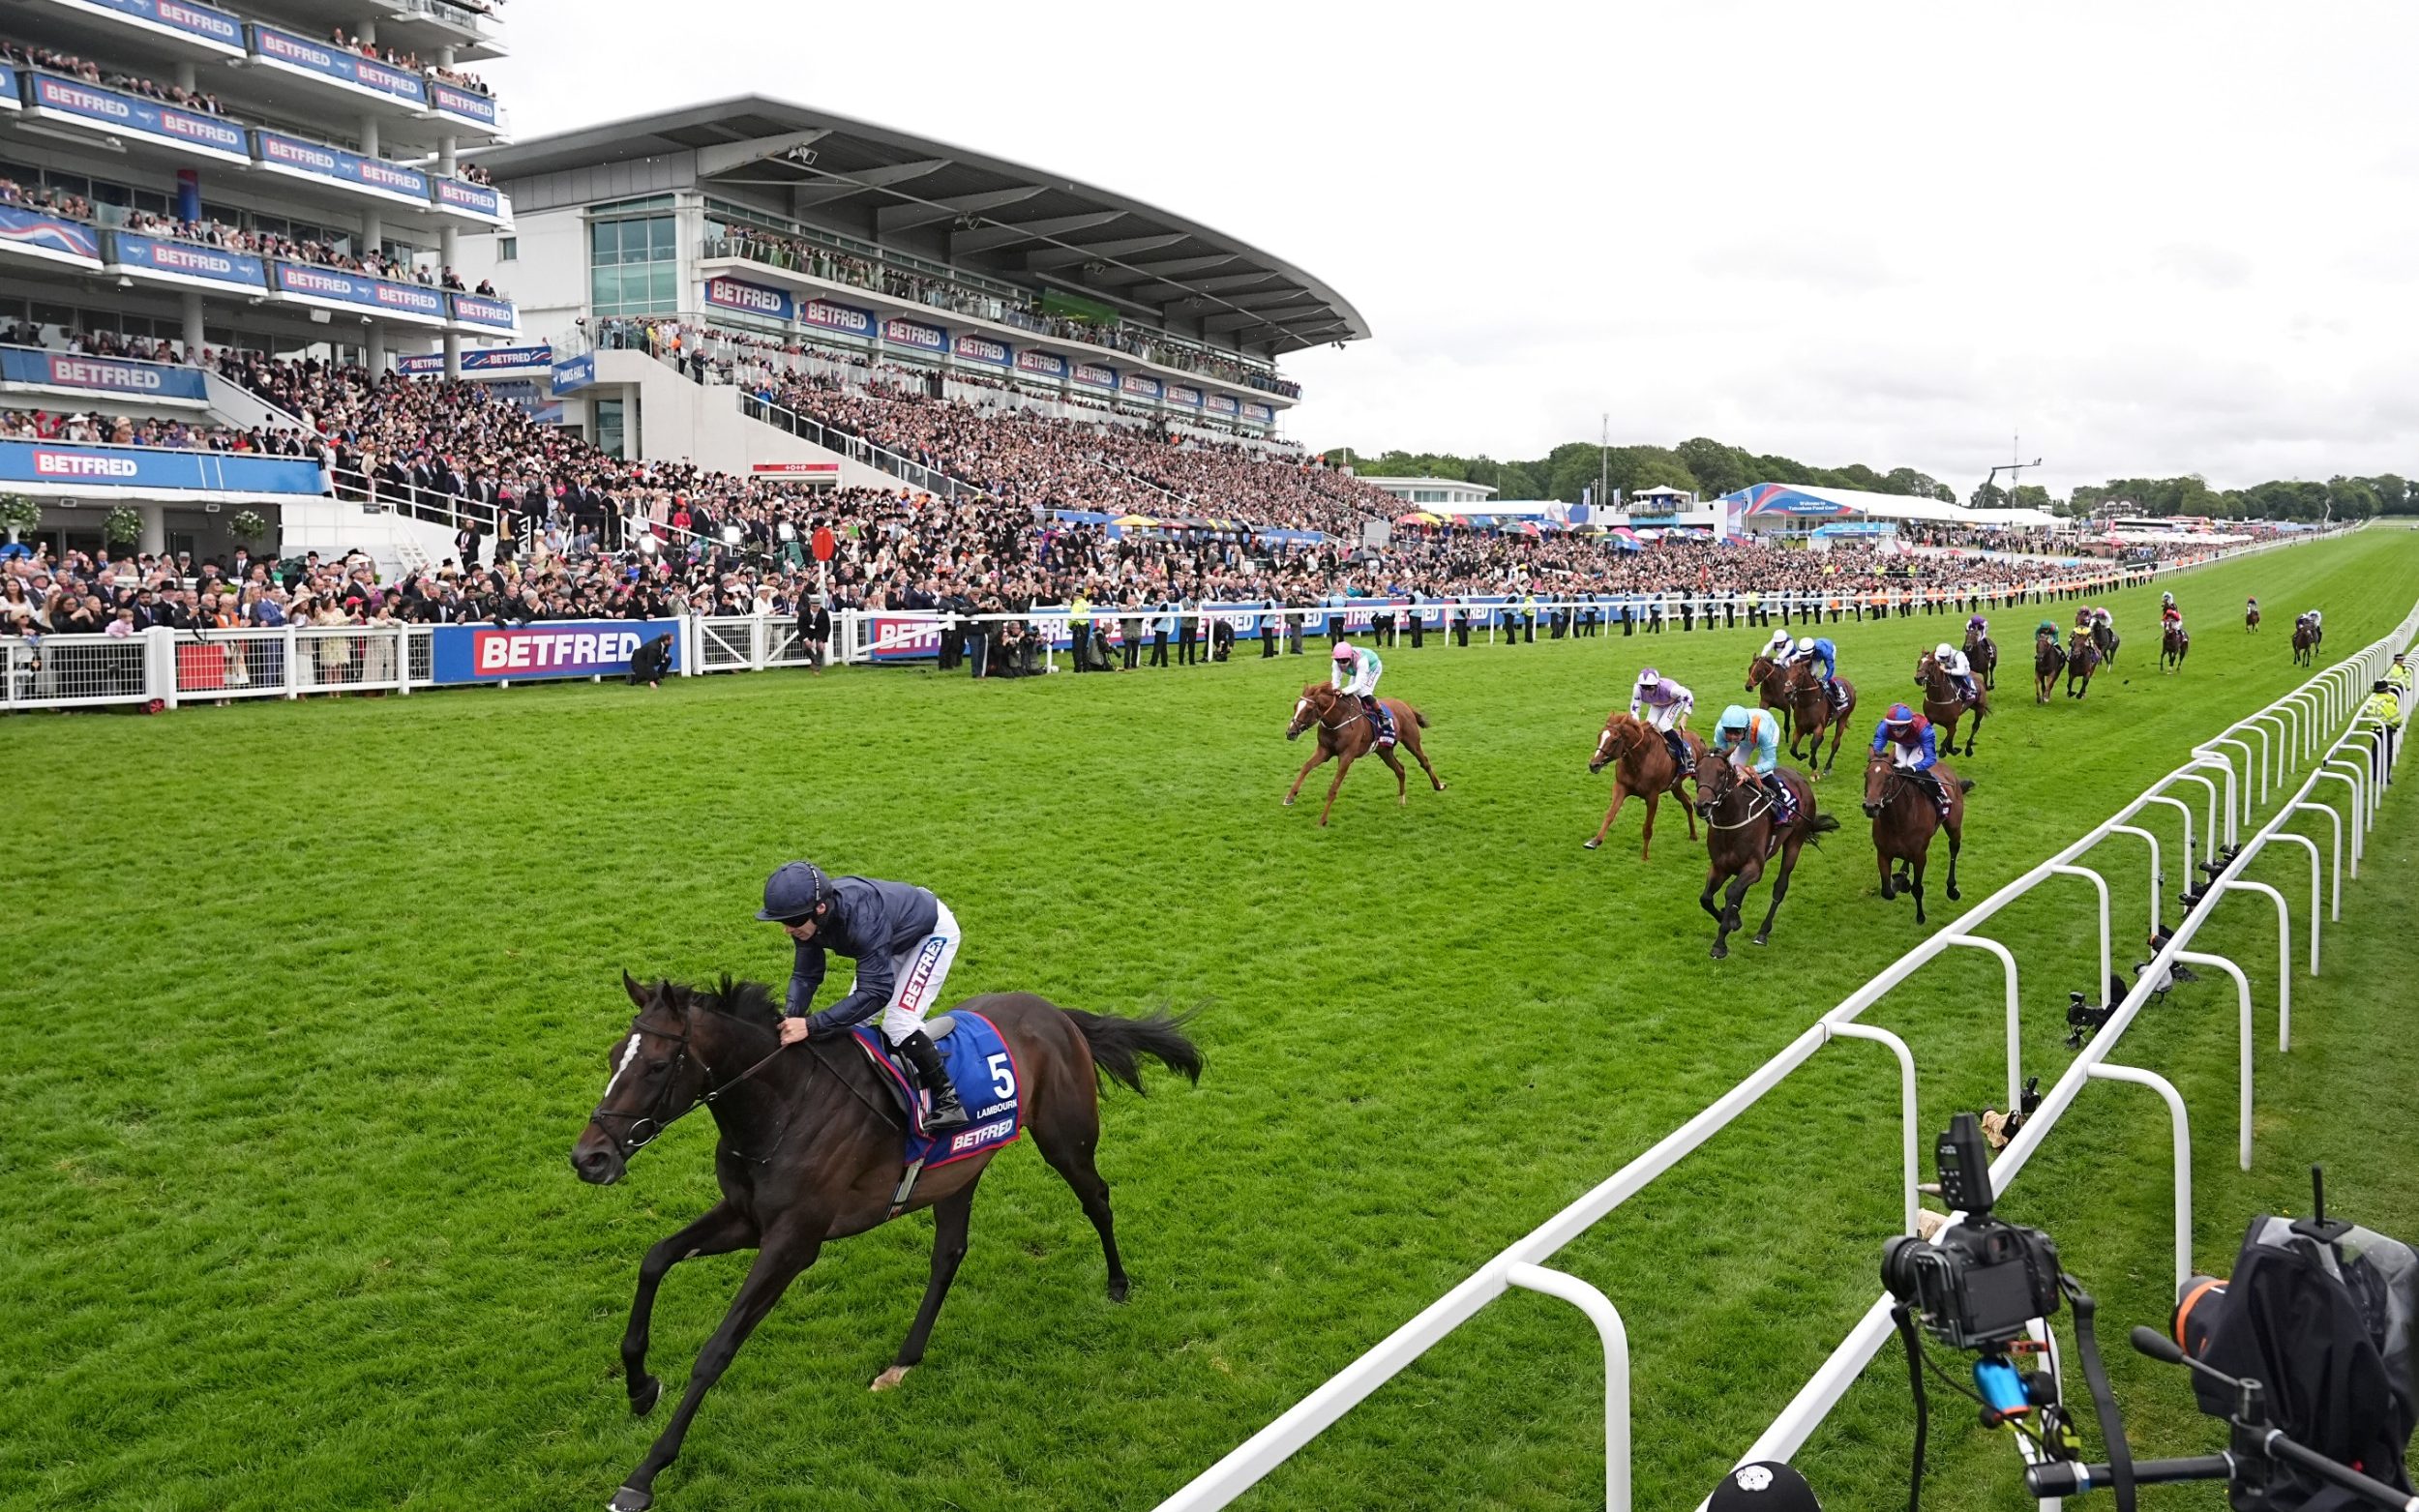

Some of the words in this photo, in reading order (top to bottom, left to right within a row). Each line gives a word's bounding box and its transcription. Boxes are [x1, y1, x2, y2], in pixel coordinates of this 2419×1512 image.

[159, 3, 234, 37] BETFRED
[265, 35, 330, 68] BETFRED
[359, 65, 418, 94] BETFRED
[46, 84, 129, 117] BETFRED
[165, 115, 238, 144] BETFRED
[439, 90, 493, 118] BETFRED
[270, 140, 335, 169] BETFRED
[362, 164, 422, 191] BETFRED
[443, 185, 496, 209] BETFRED
[156, 248, 230, 274] BETFRED
[286, 271, 351, 295] BETFRED
[378, 287, 437, 309] BETFRED
[713, 280, 782, 311] BETFRED
[460, 301, 511, 323] BETFRED
[809, 304, 867, 330] BETFRED
[889, 324, 941, 347] BETFRED
[491, 353, 530, 364] BETFRED
[960, 339, 1005, 361] BETFRED
[56, 361, 161, 389] BETFRED
[411, 358, 444, 370] BETFRE
[559, 368, 575, 384] OAKS
[574, 365, 585, 380] HALL
[1022, 354, 1061, 373] BETFRED
[1077, 367, 1113, 385] BETFRED
[1125, 379, 1157, 395] BETFRED
[1169, 389, 1198, 403] BETFRED
[40, 454, 137, 477] BETFRED
[482, 633, 641, 667] BETFRED
[987, 1052, 1015, 1099] 5
[976, 1099, 1018, 1119] LAMBOURN
[953, 1119, 1013, 1151] BETFRED
